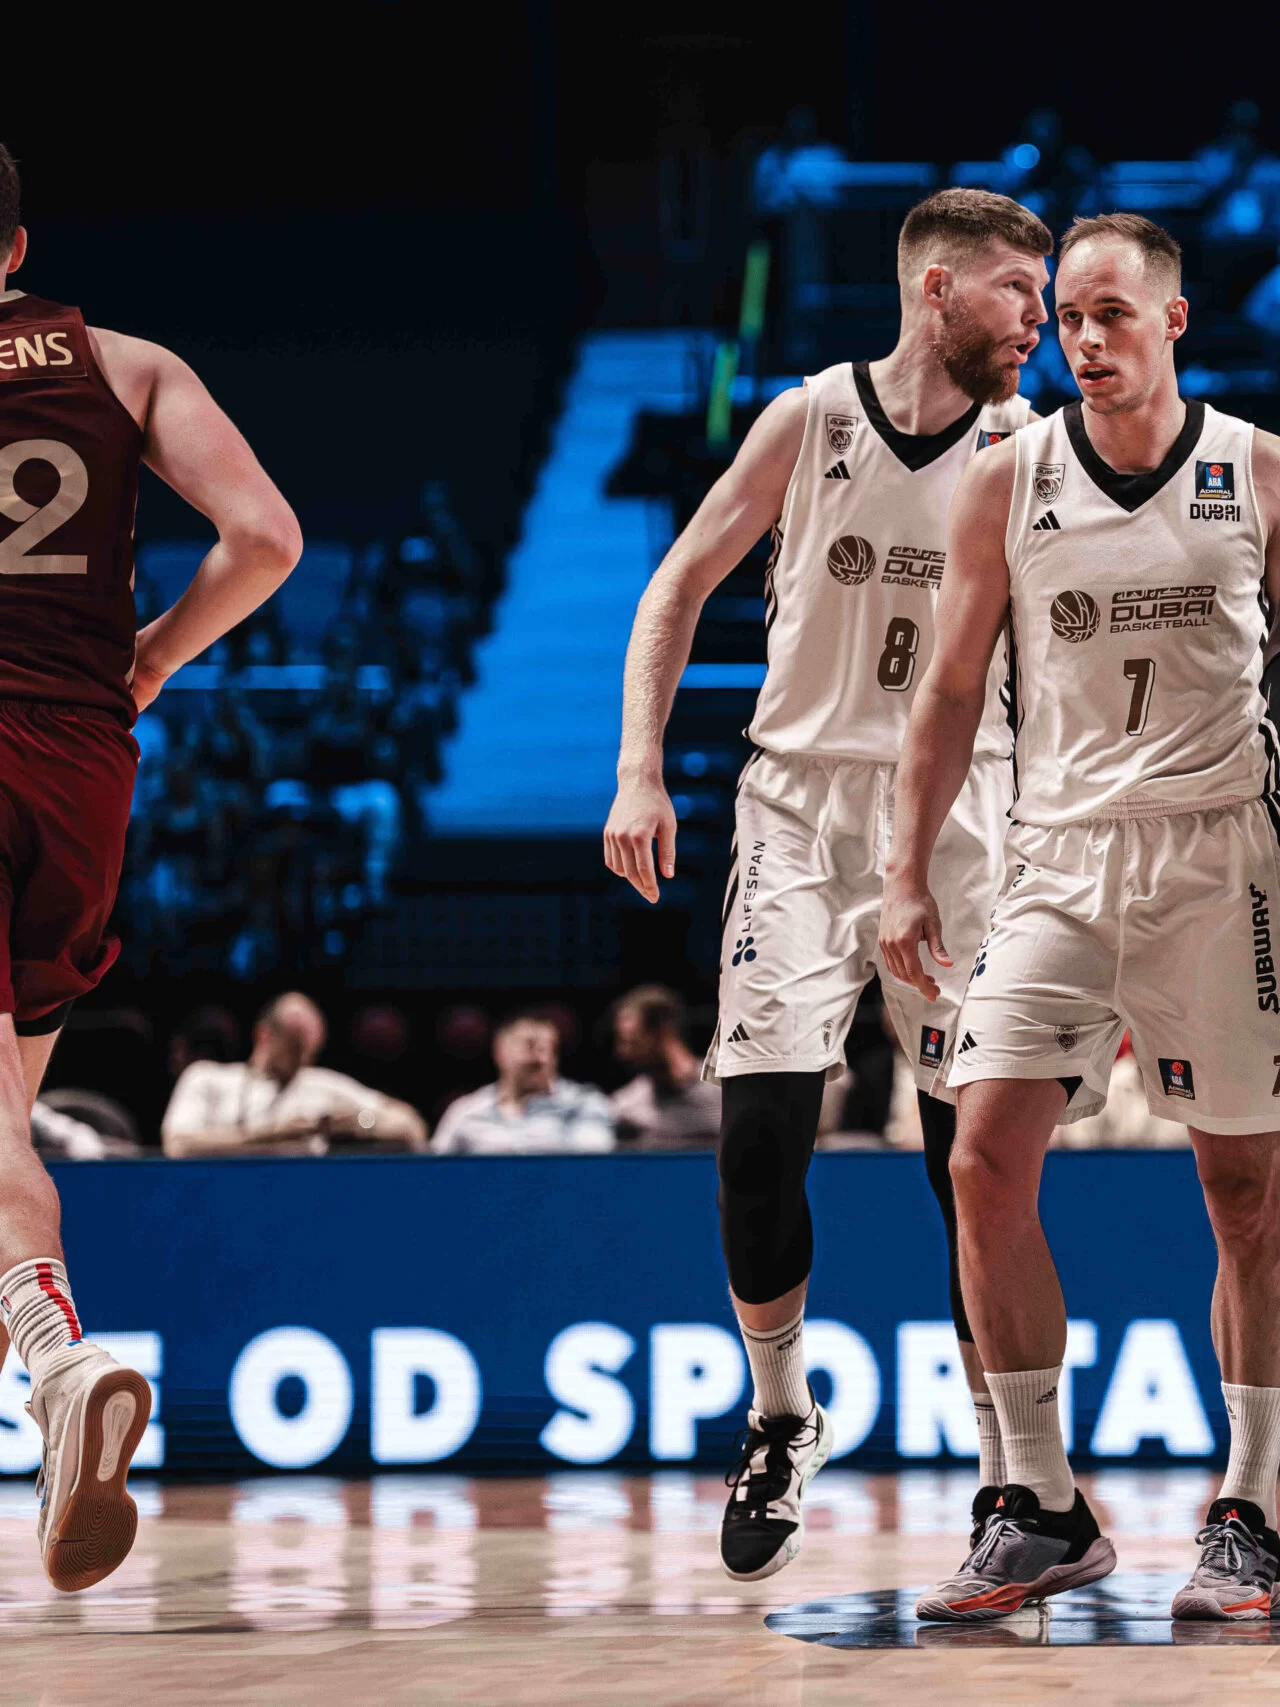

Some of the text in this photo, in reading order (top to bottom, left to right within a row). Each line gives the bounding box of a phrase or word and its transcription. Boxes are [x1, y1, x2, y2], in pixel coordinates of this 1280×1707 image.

[0, 439, 89, 575] 2
[1207, 477, 1223, 487] ABA
[1190, 503, 1241, 522] DUBAI
[881, 575, 942, 590] BASKET
[883, 559, 945, 581] DUB
[1110, 617, 1210, 634] BASKETBALL
[1111, 599, 1215, 623] DUBAI
[876, 616, 919, 692] 8
[1123, 658, 1156, 736] 7
[741, 841, 766, 933] LIFESPAN
[1248, 882, 1280, 1015] SUBWAY
[228, 1325, 482, 1469] OD
